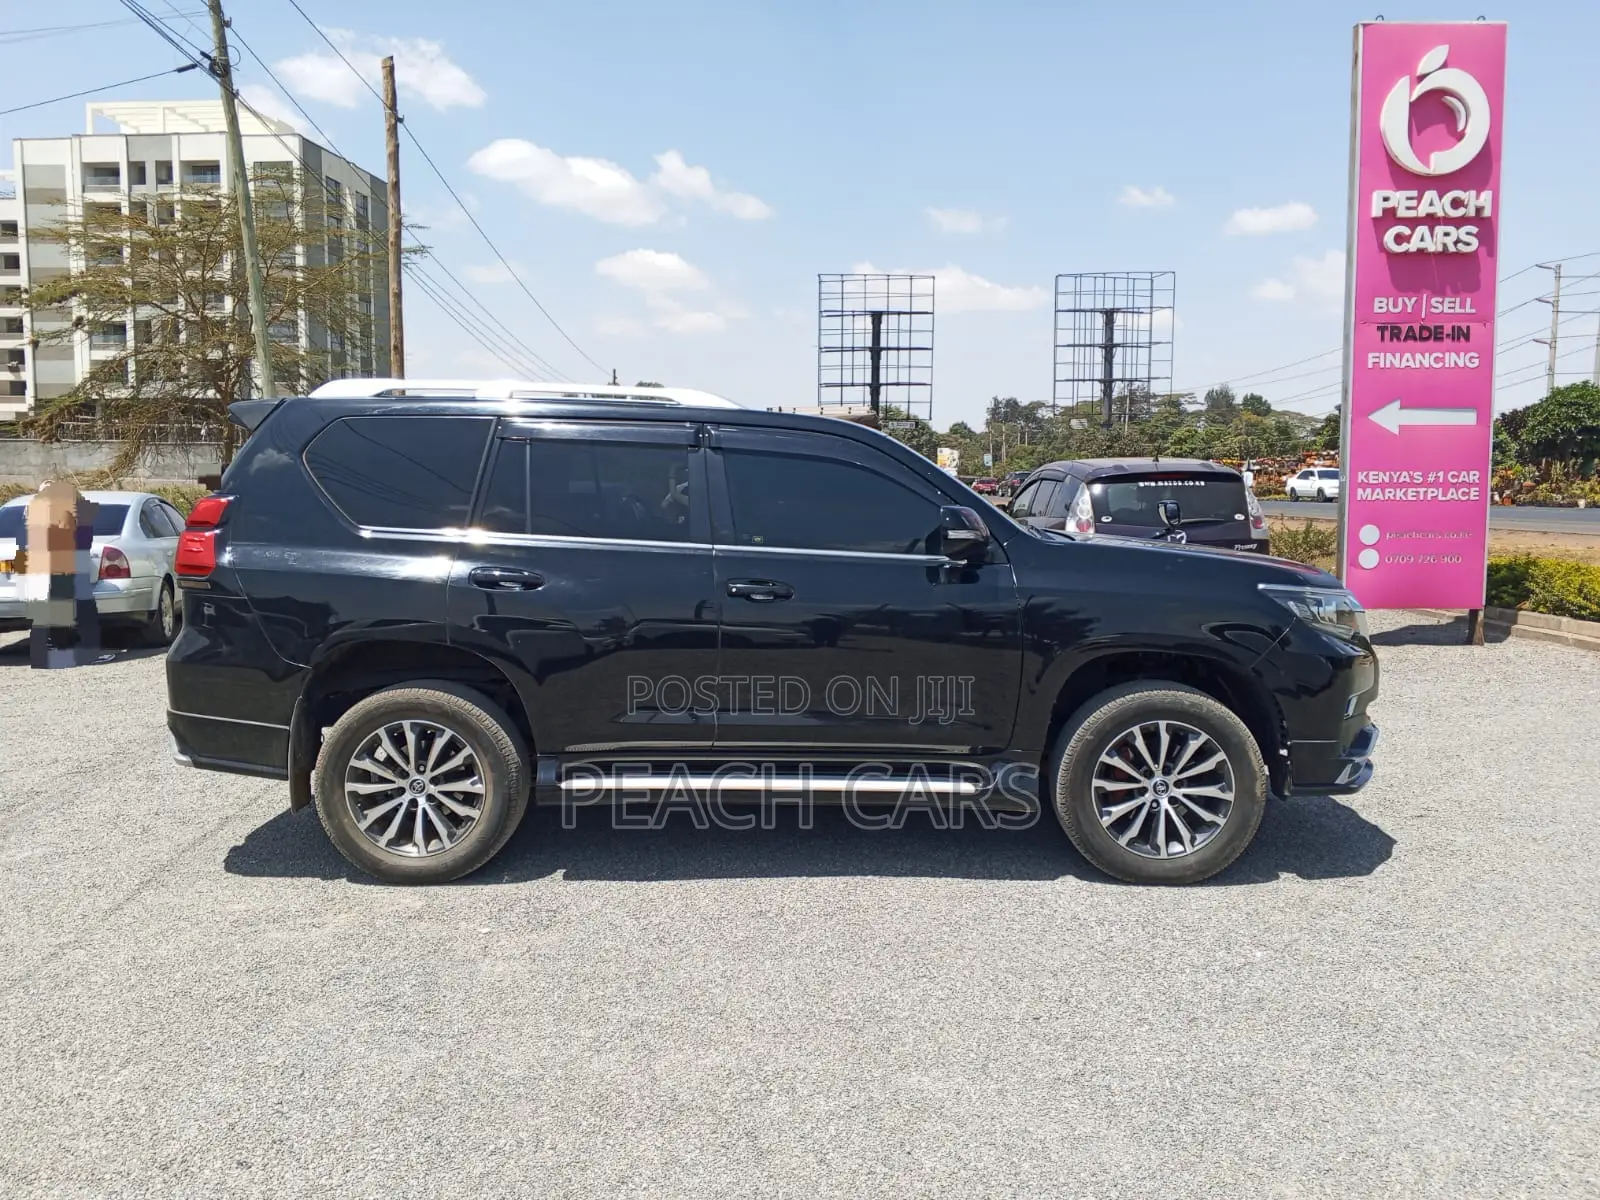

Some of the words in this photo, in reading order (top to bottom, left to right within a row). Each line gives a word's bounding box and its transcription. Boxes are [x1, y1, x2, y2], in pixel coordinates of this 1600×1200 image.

[1371, 190, 1493, 218] PEACH
[1383, 225, 1479, 253] CARS
[1373, 297, 1417, 313] BUY
[1430, 297, 1476, 313] SELL
[1376, 325, 1471, 342] TRADE-IN
[1367, 352, 1480, 369] FINANCING
[1357, 471, 1423, 484] KENYA'S
[1427, 471, 1444, 484] #1
[1447, 471, 1480, 484] CAR
[1356, 487, 1480, 501] MARKETPLACE
[1385, 554, 1414, 564] 0709
